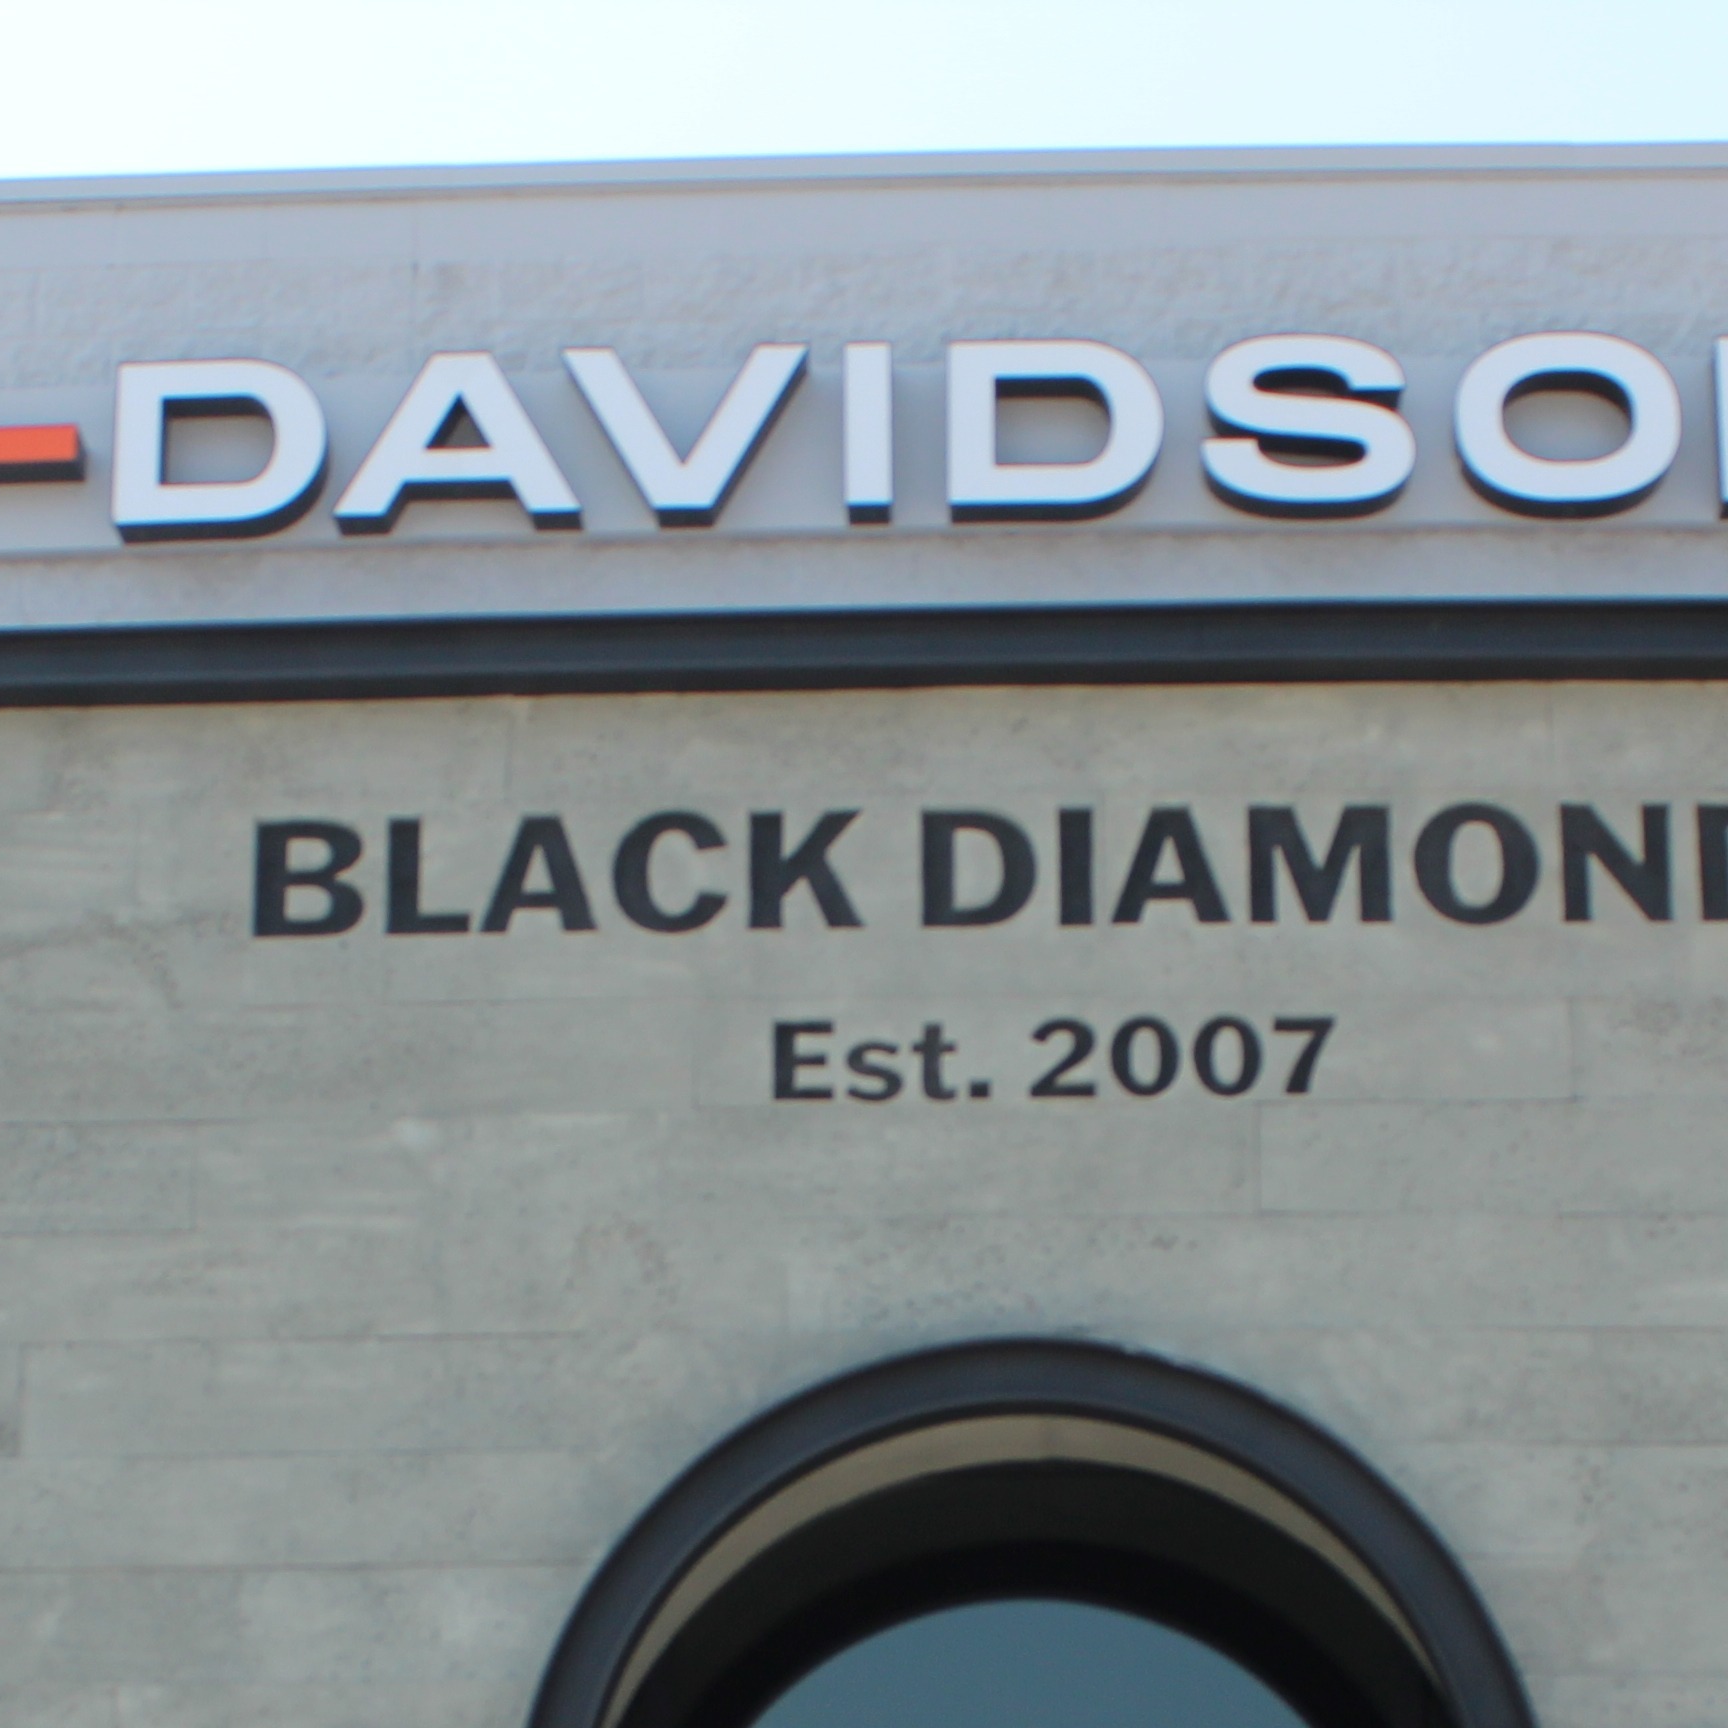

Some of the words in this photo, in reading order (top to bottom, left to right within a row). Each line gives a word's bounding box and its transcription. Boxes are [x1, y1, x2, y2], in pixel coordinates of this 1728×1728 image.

[251, 808, 864, 939] BLACK
[771, 1018, 992, 1104] Est.
[1028, 1014, 1336, 1100] 2007
